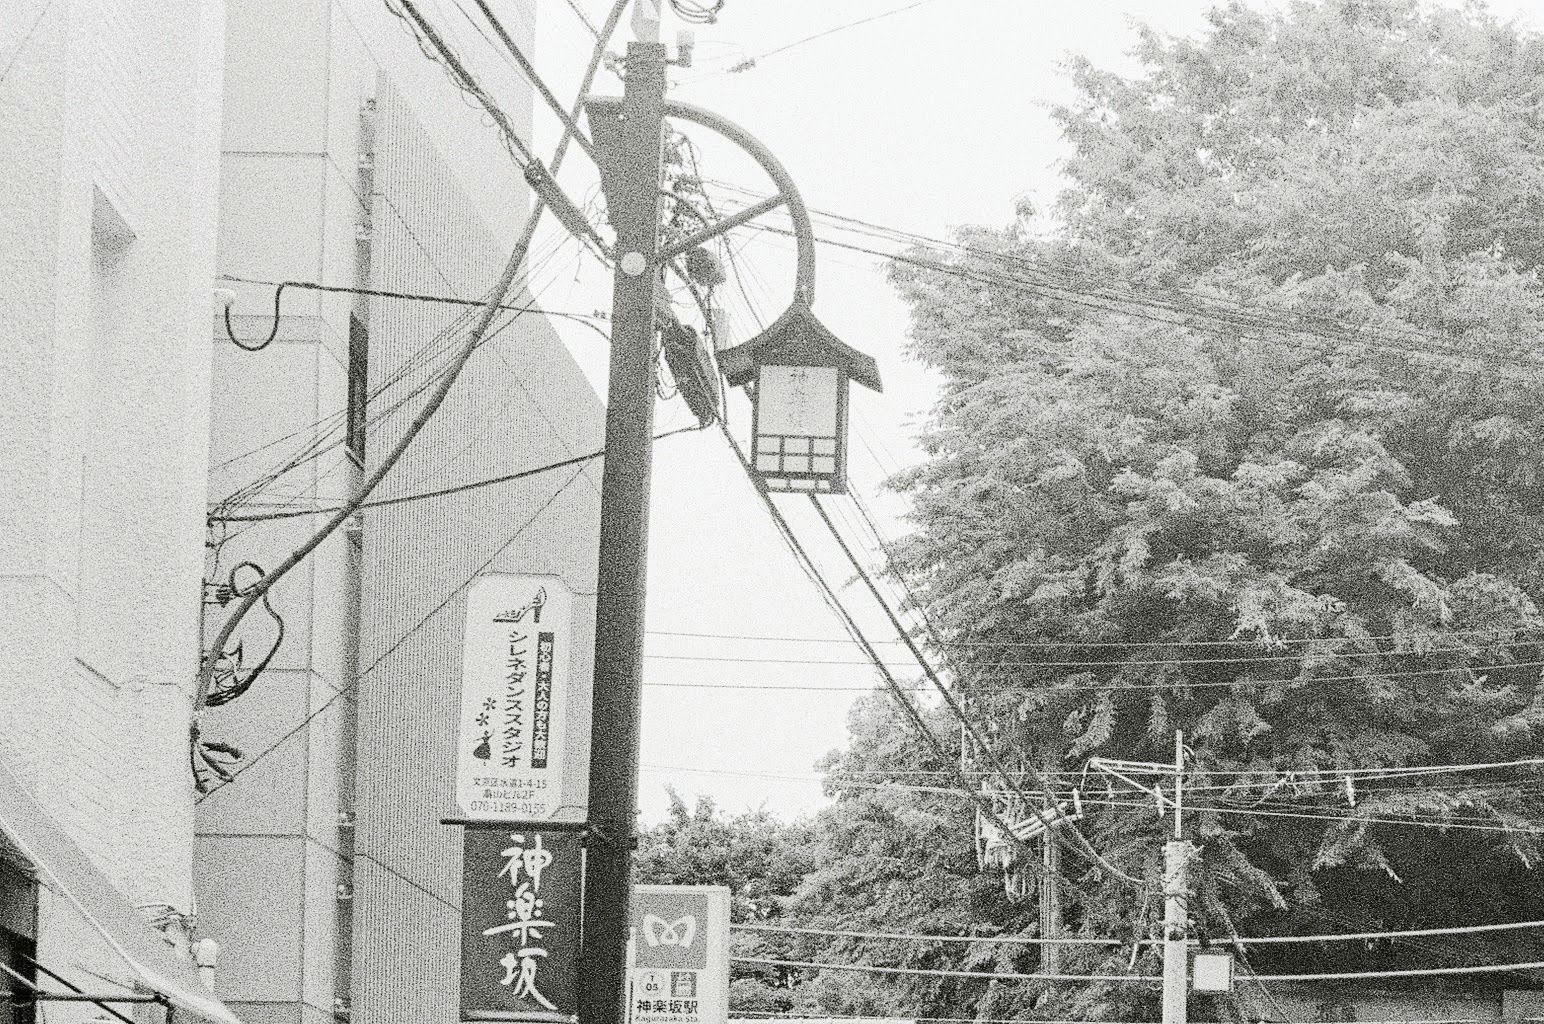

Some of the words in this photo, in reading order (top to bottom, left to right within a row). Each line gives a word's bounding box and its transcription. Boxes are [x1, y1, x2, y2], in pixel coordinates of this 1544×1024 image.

[501, 630, 528, 768] シレネダンススタジオ
[482, 833, 557, 1011] 神楽坂
[636, 1000, 698, 1015] 神楽坂駅
